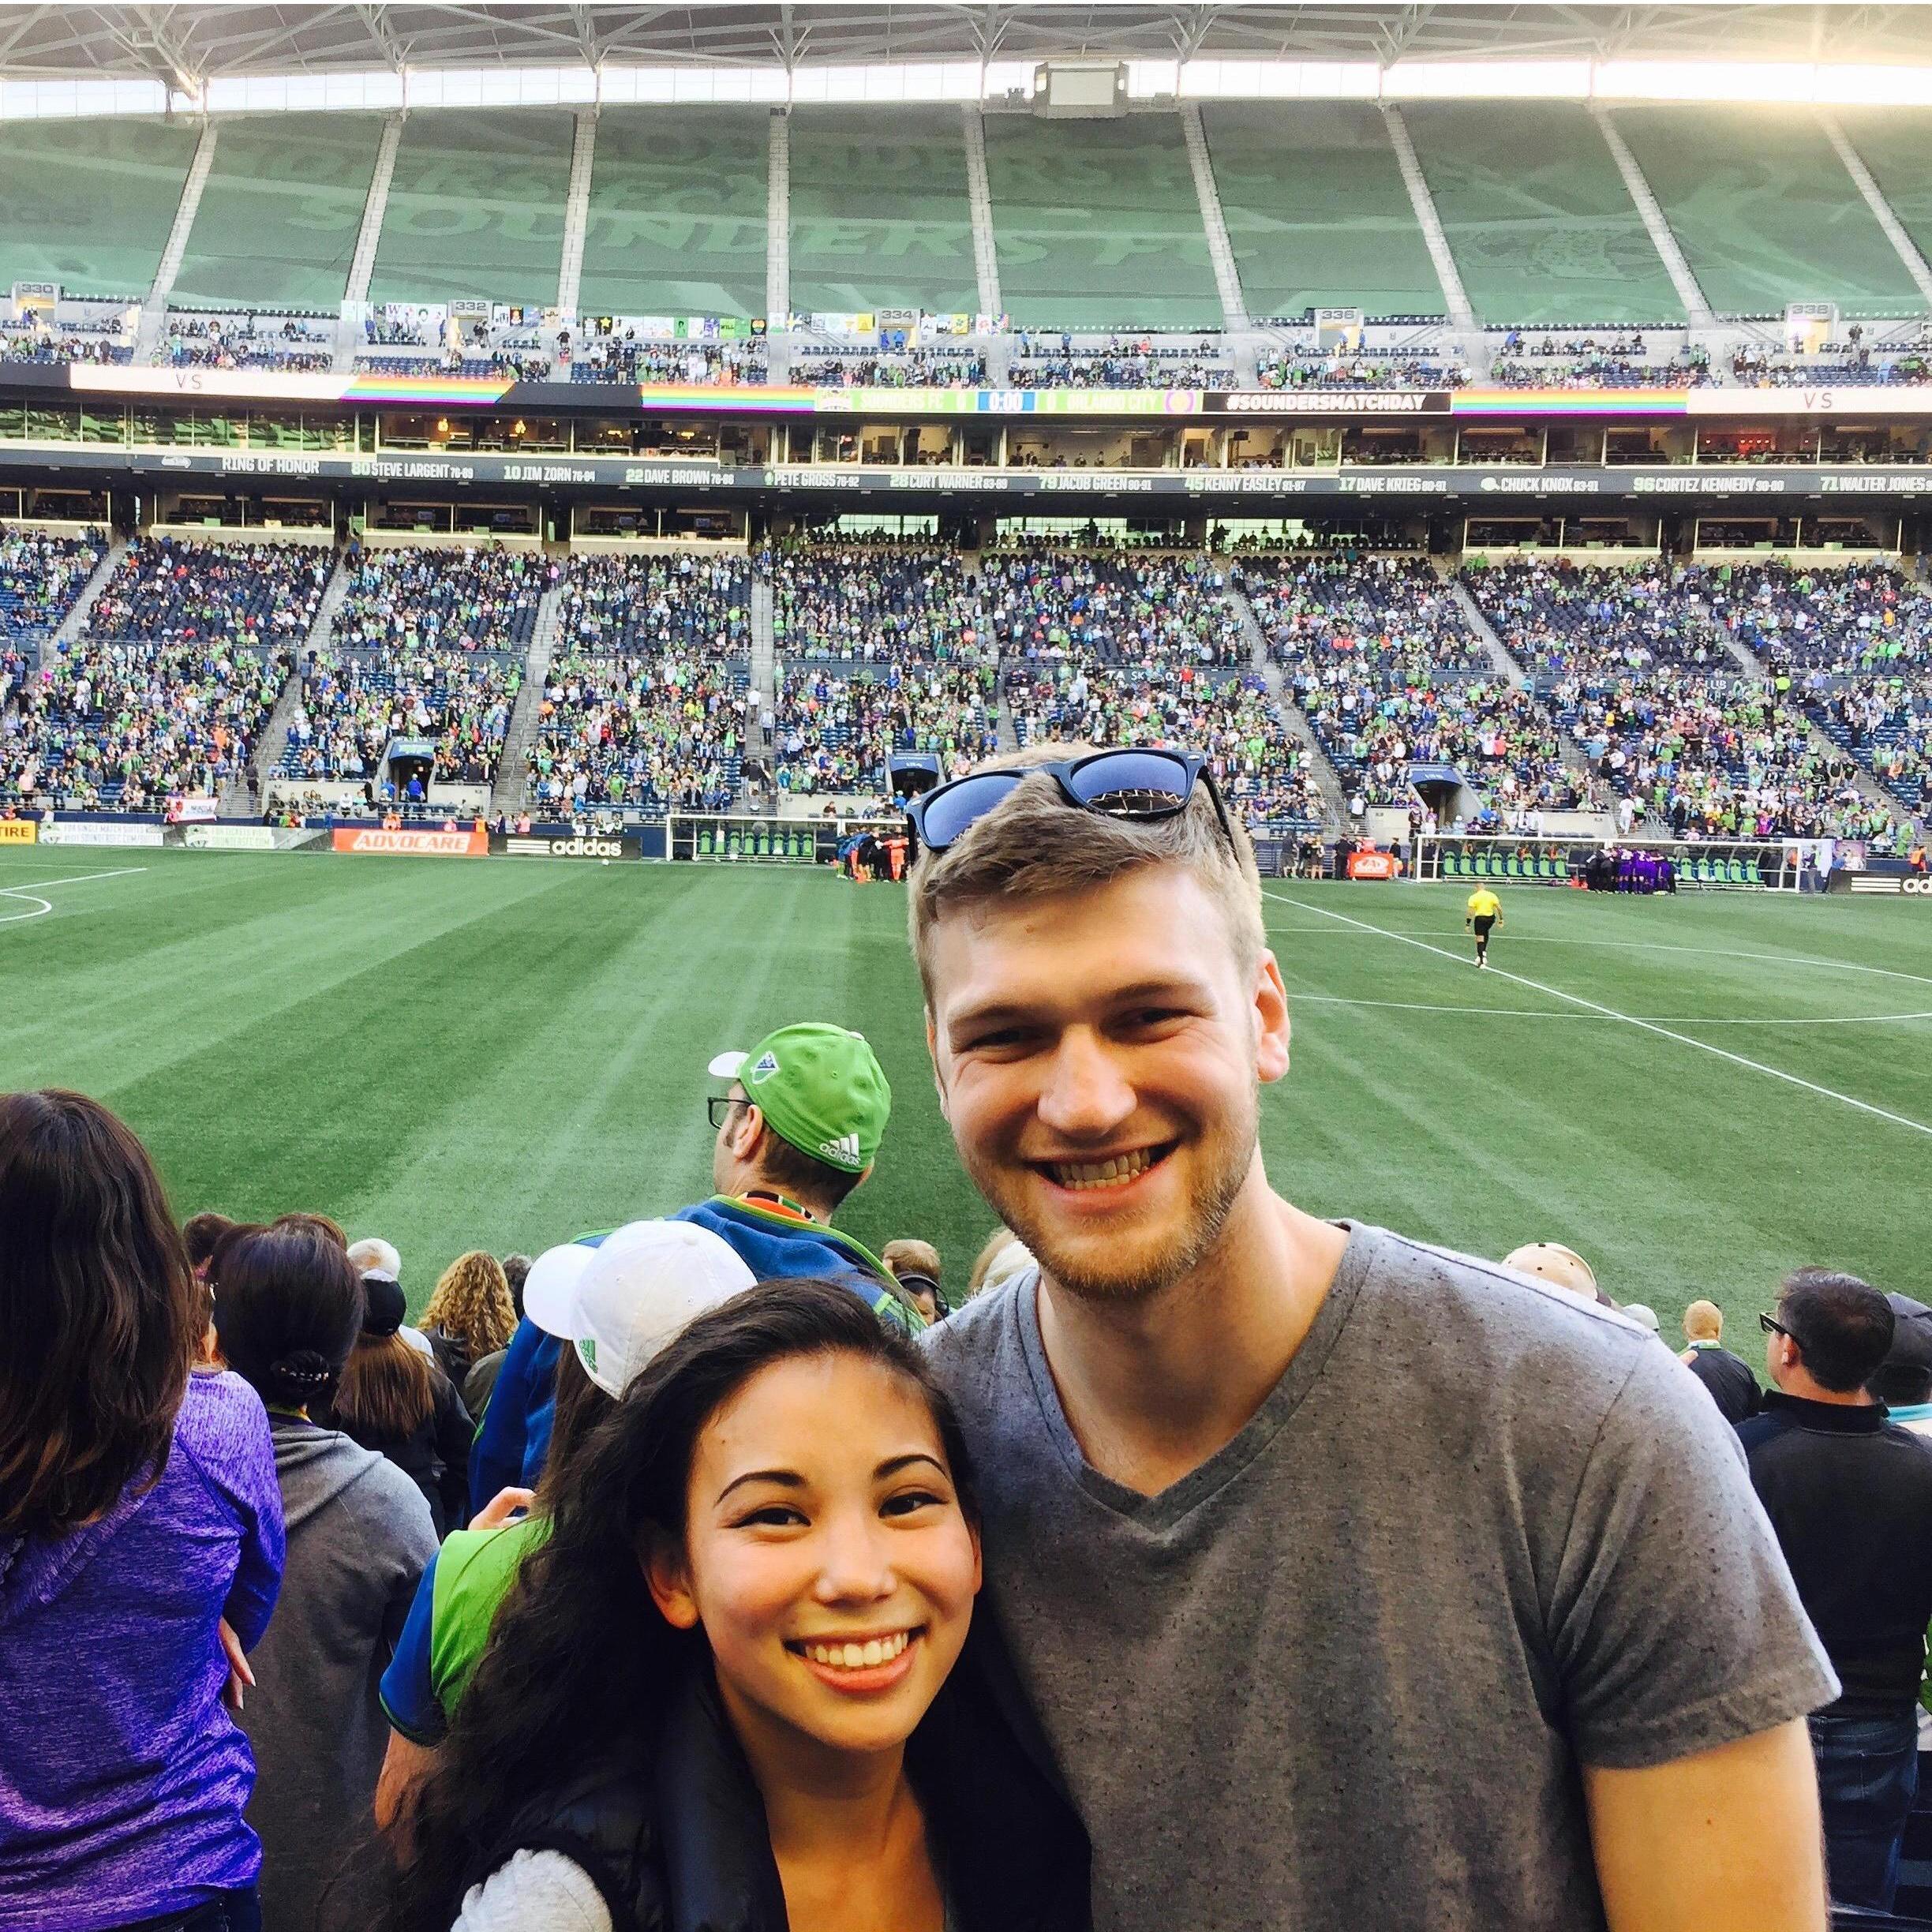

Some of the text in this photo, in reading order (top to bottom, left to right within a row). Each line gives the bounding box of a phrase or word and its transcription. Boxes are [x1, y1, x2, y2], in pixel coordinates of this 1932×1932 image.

[22, 284, 53, 293] 330
[455, 301, 486, 311] 332
[1792, 305, 1829, 314] 338
[882, 310, 913, 319] 334
[1322, 310, 1354, 320] 336
[176, 374, 202, 389] VS
[989, 391, 1024, 411] 0:00
[1226, 395, 1426, 410] #SOUNDERSMATCHDAY
[1804, 391, 1832, 409] VS
[222, 457, 320, 474] RING OF HONOR
[371, 462, 402, 477] STEVE
[404, 463, 451, 478] LARGENT
[504, 466, 520, 480] 10
[521, 466, 542, 481] JIM
[544, 466, 571, 481] ZORN
[626, 469, 643, 482] 22
[644, 469, 670, 484] DAVE
[672, 470, 710, 485] BROWN
[774, 472, 799, 487] PETE
[801, 473, 836, 487] GROSS
[909, 475, 936, 489] CURT
[937, 475, 983, 489] WARNER
[1039, 476, 1057, 489] 79
[1058, 477, 1091, 490] JACOB
[1093, 477, 1128, 490] GREEN
[1185, 477, 1204, 490] 45
[1205, 477, 1241, 491] KENNY
[1242, 477, 1282, 491] EASLEY
[1339, 477, 1356, 490] 17
[1357, 477, 1384, 491] DAVE
[1387, 477, 1422, 491] KRIEG
[1501, 477, 1540, 491] CHUCK
[1541, 477, 1574, 491] KNOX
[1634, 477, 1655, 491] 96
[1656, 477, 1698, 492] CORTEZ
[1702, 477, 1757, 492] KENNEDY
[1821, 477, 1926, 492] 71 WALTER JONES
[357, 833, 471, 851] ADVOCARE
[552, 838, 622, 856] adidas
[818, 1142, 861, 1167] adidas
